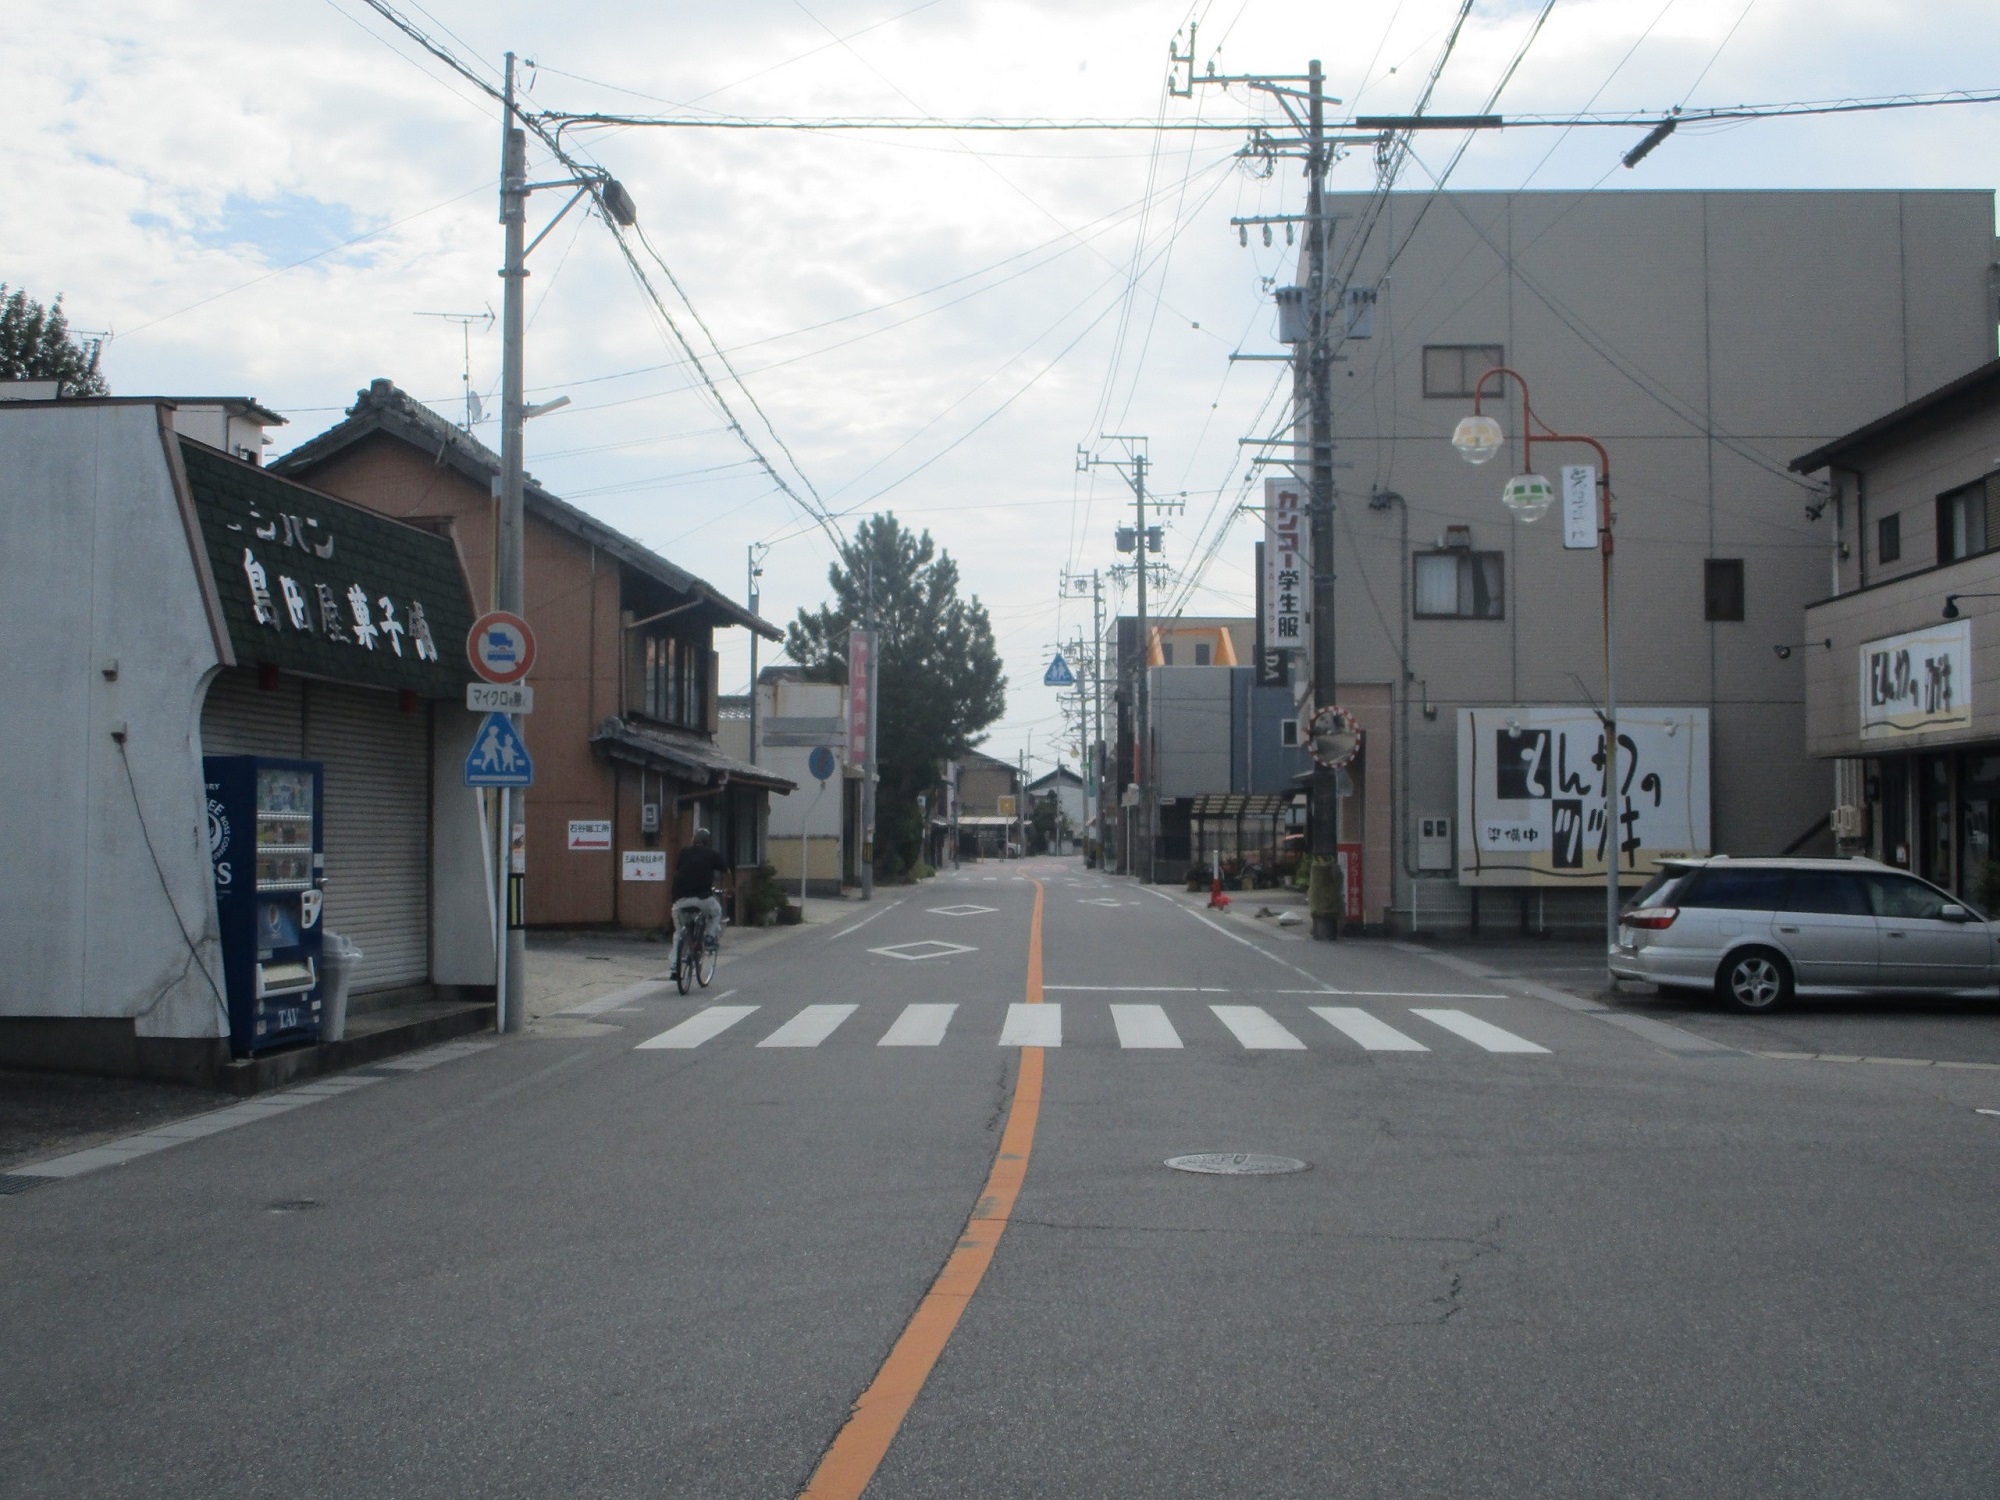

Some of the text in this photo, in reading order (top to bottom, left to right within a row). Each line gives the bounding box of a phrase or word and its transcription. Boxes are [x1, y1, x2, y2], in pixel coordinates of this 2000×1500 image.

[1278, 490, 1299, 638] カンコー学生服
[1520, 732, 1662, 807] とんかつの
[206, 799, 225, 815] EE
[1487, 826, 1538, 842] 準備中
